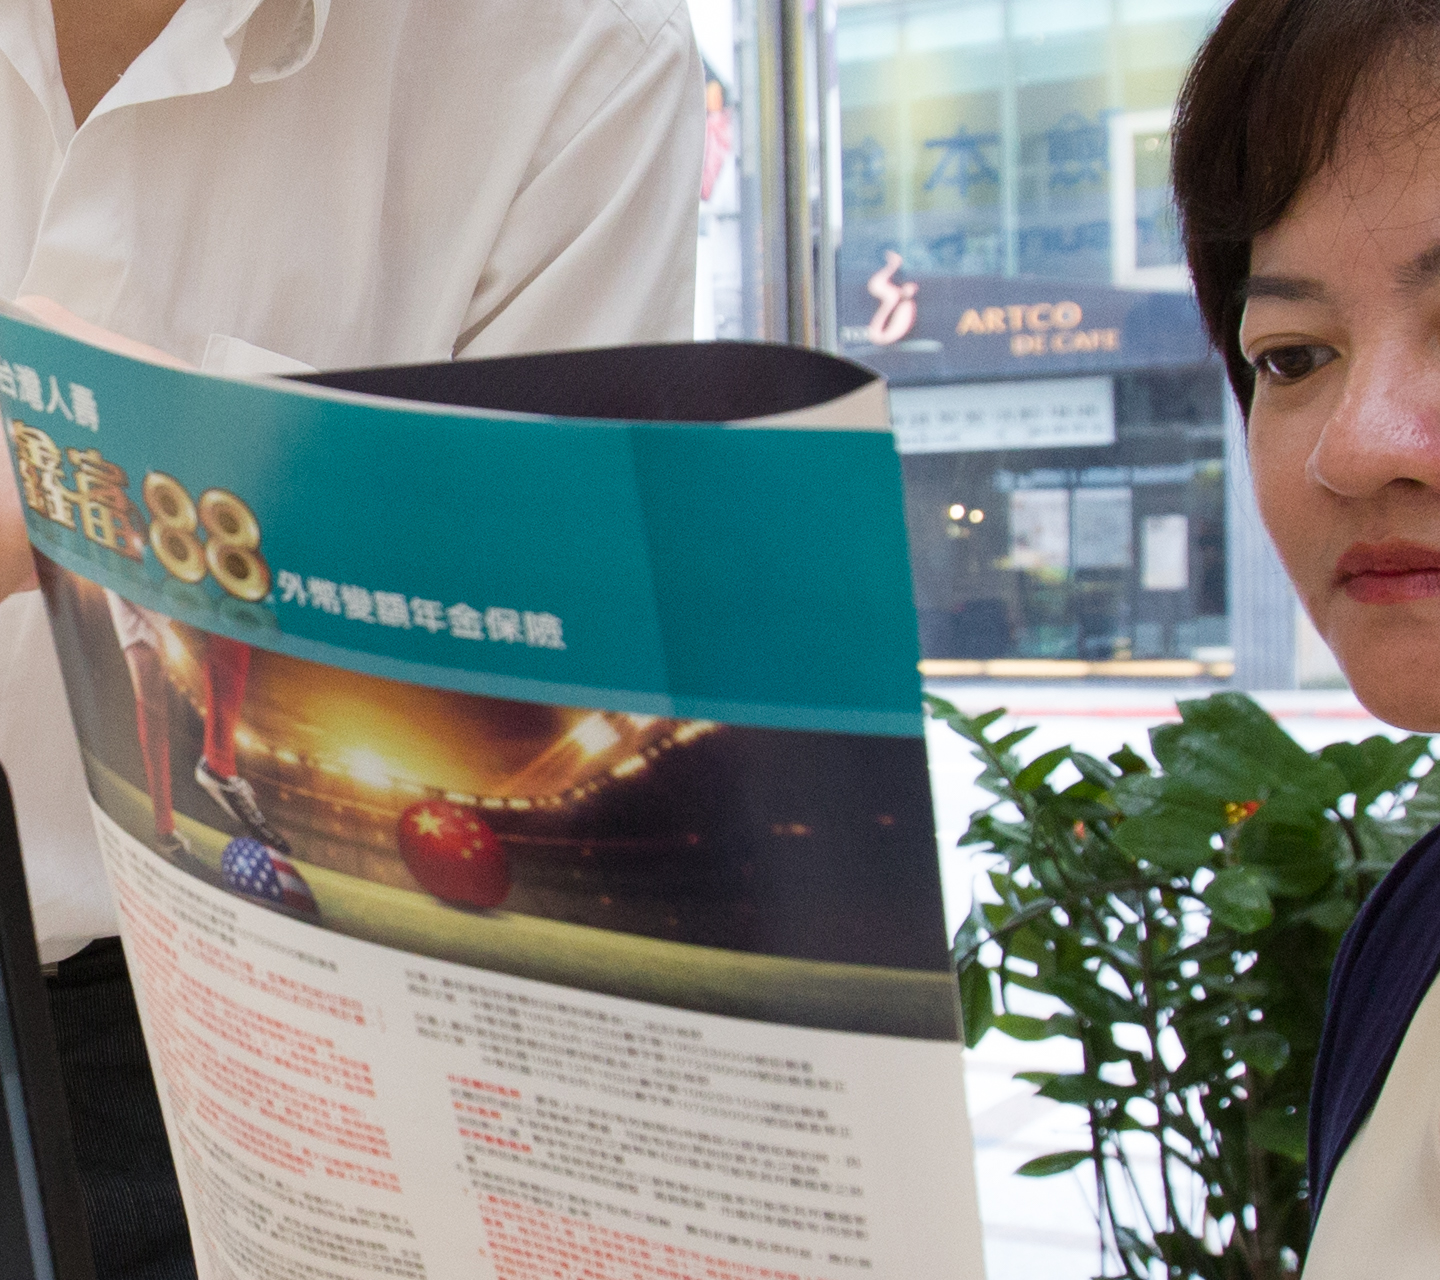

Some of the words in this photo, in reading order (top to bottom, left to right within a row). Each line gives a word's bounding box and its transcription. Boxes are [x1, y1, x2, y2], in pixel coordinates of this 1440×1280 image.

[957, 300, 1084, 337] ARTCO
[277, 568, 568, 652] 外幣變額年金保險
